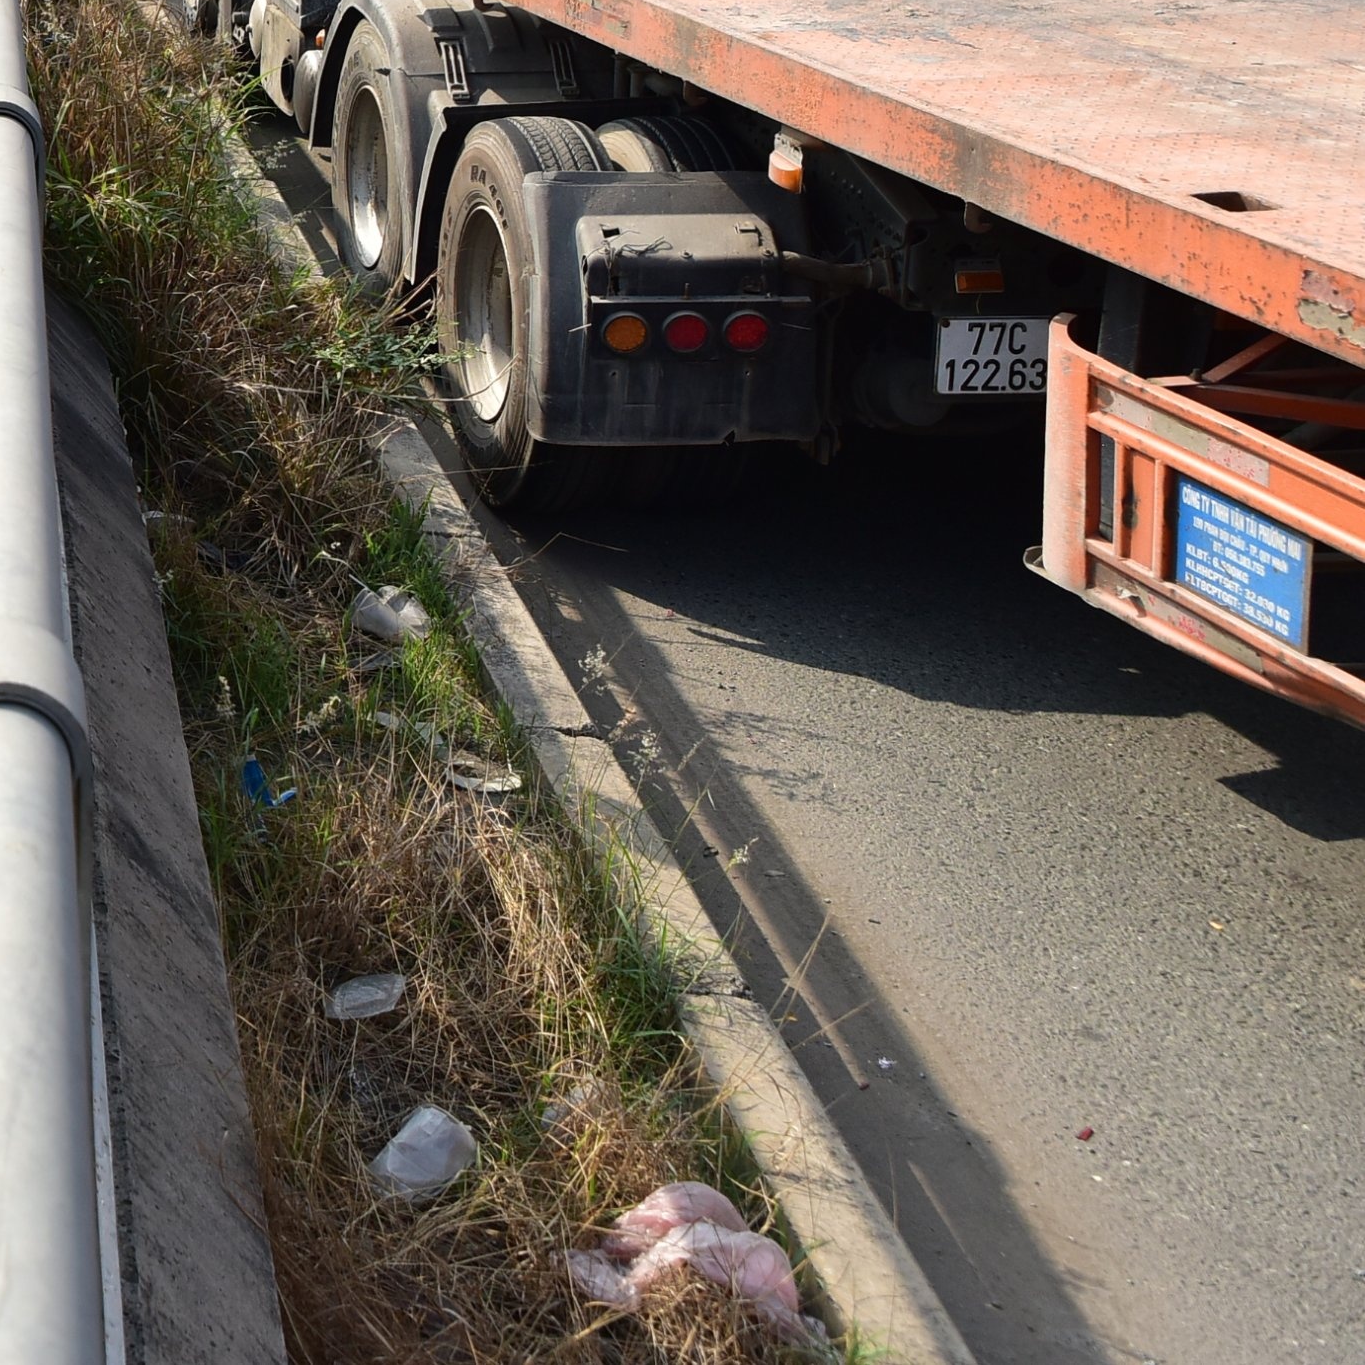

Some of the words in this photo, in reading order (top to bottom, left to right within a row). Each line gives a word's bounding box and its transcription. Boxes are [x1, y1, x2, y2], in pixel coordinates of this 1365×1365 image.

[967, 322, 1028, 356] 77C
[944, 358, 1048, 392] 122.63
[1201, 494, 1210, 514] TY
